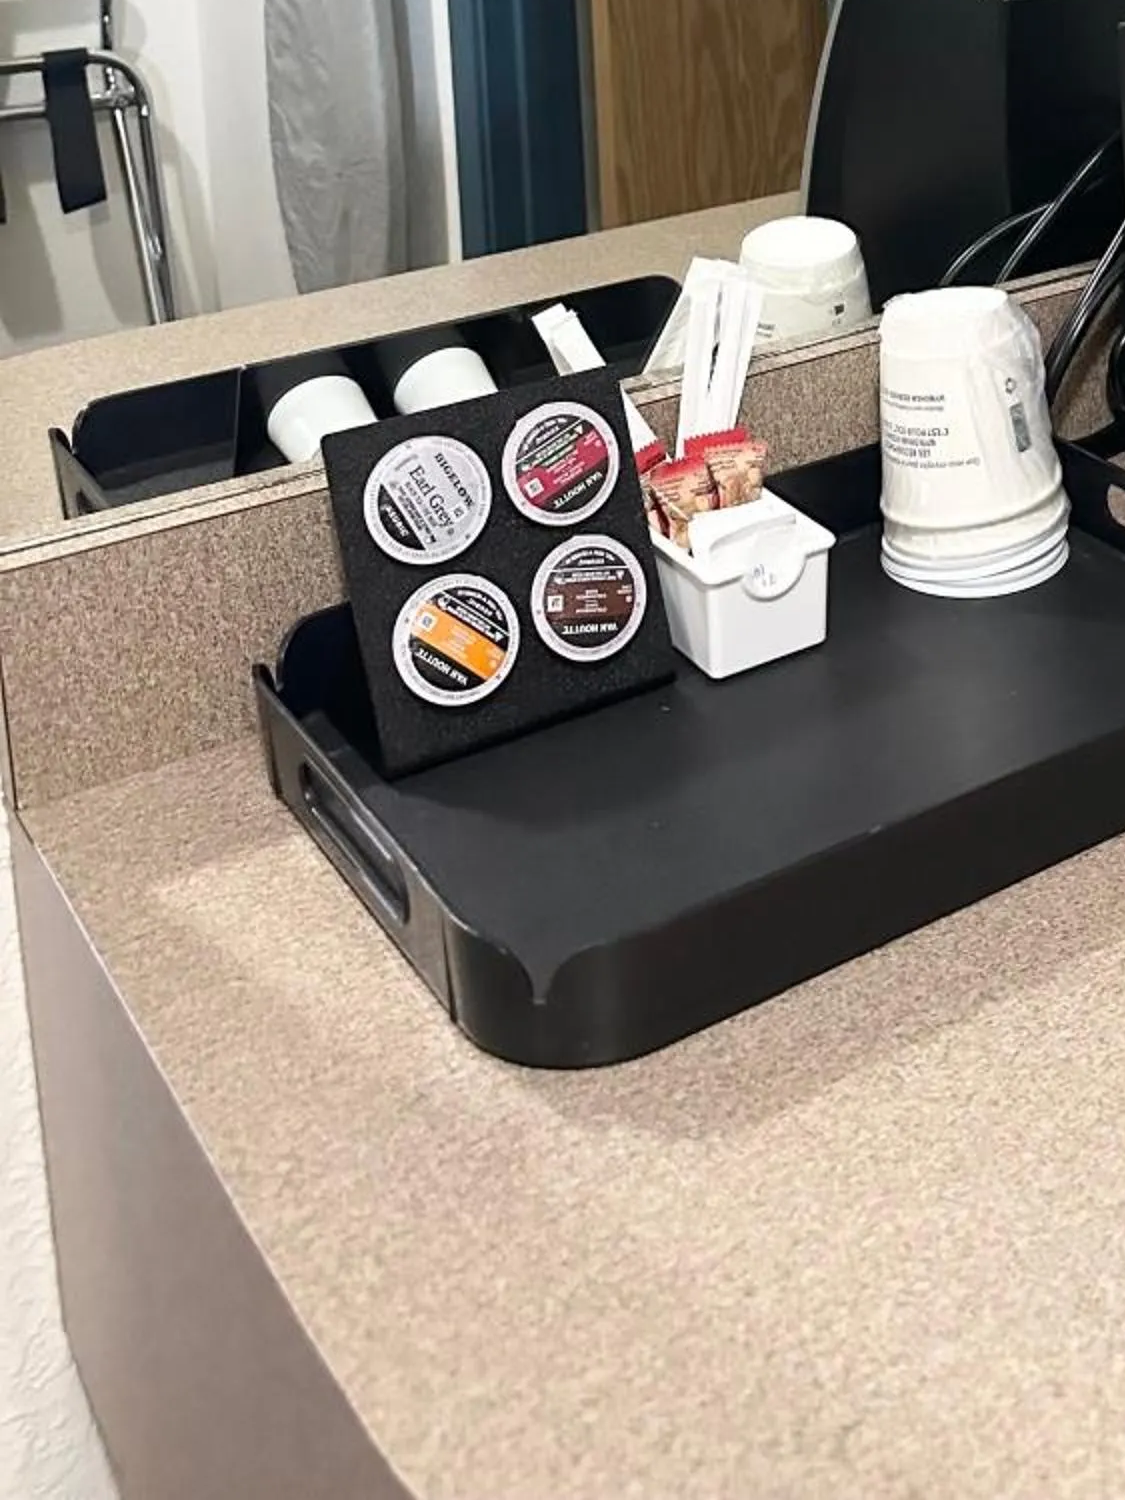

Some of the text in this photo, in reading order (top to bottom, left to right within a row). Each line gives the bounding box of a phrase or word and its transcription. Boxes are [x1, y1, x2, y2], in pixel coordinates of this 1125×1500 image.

[408, 465, 436, 497] Earl
[429, 494, 454, 527] Grey
[434, 452, 474, 508] BIGELOW
